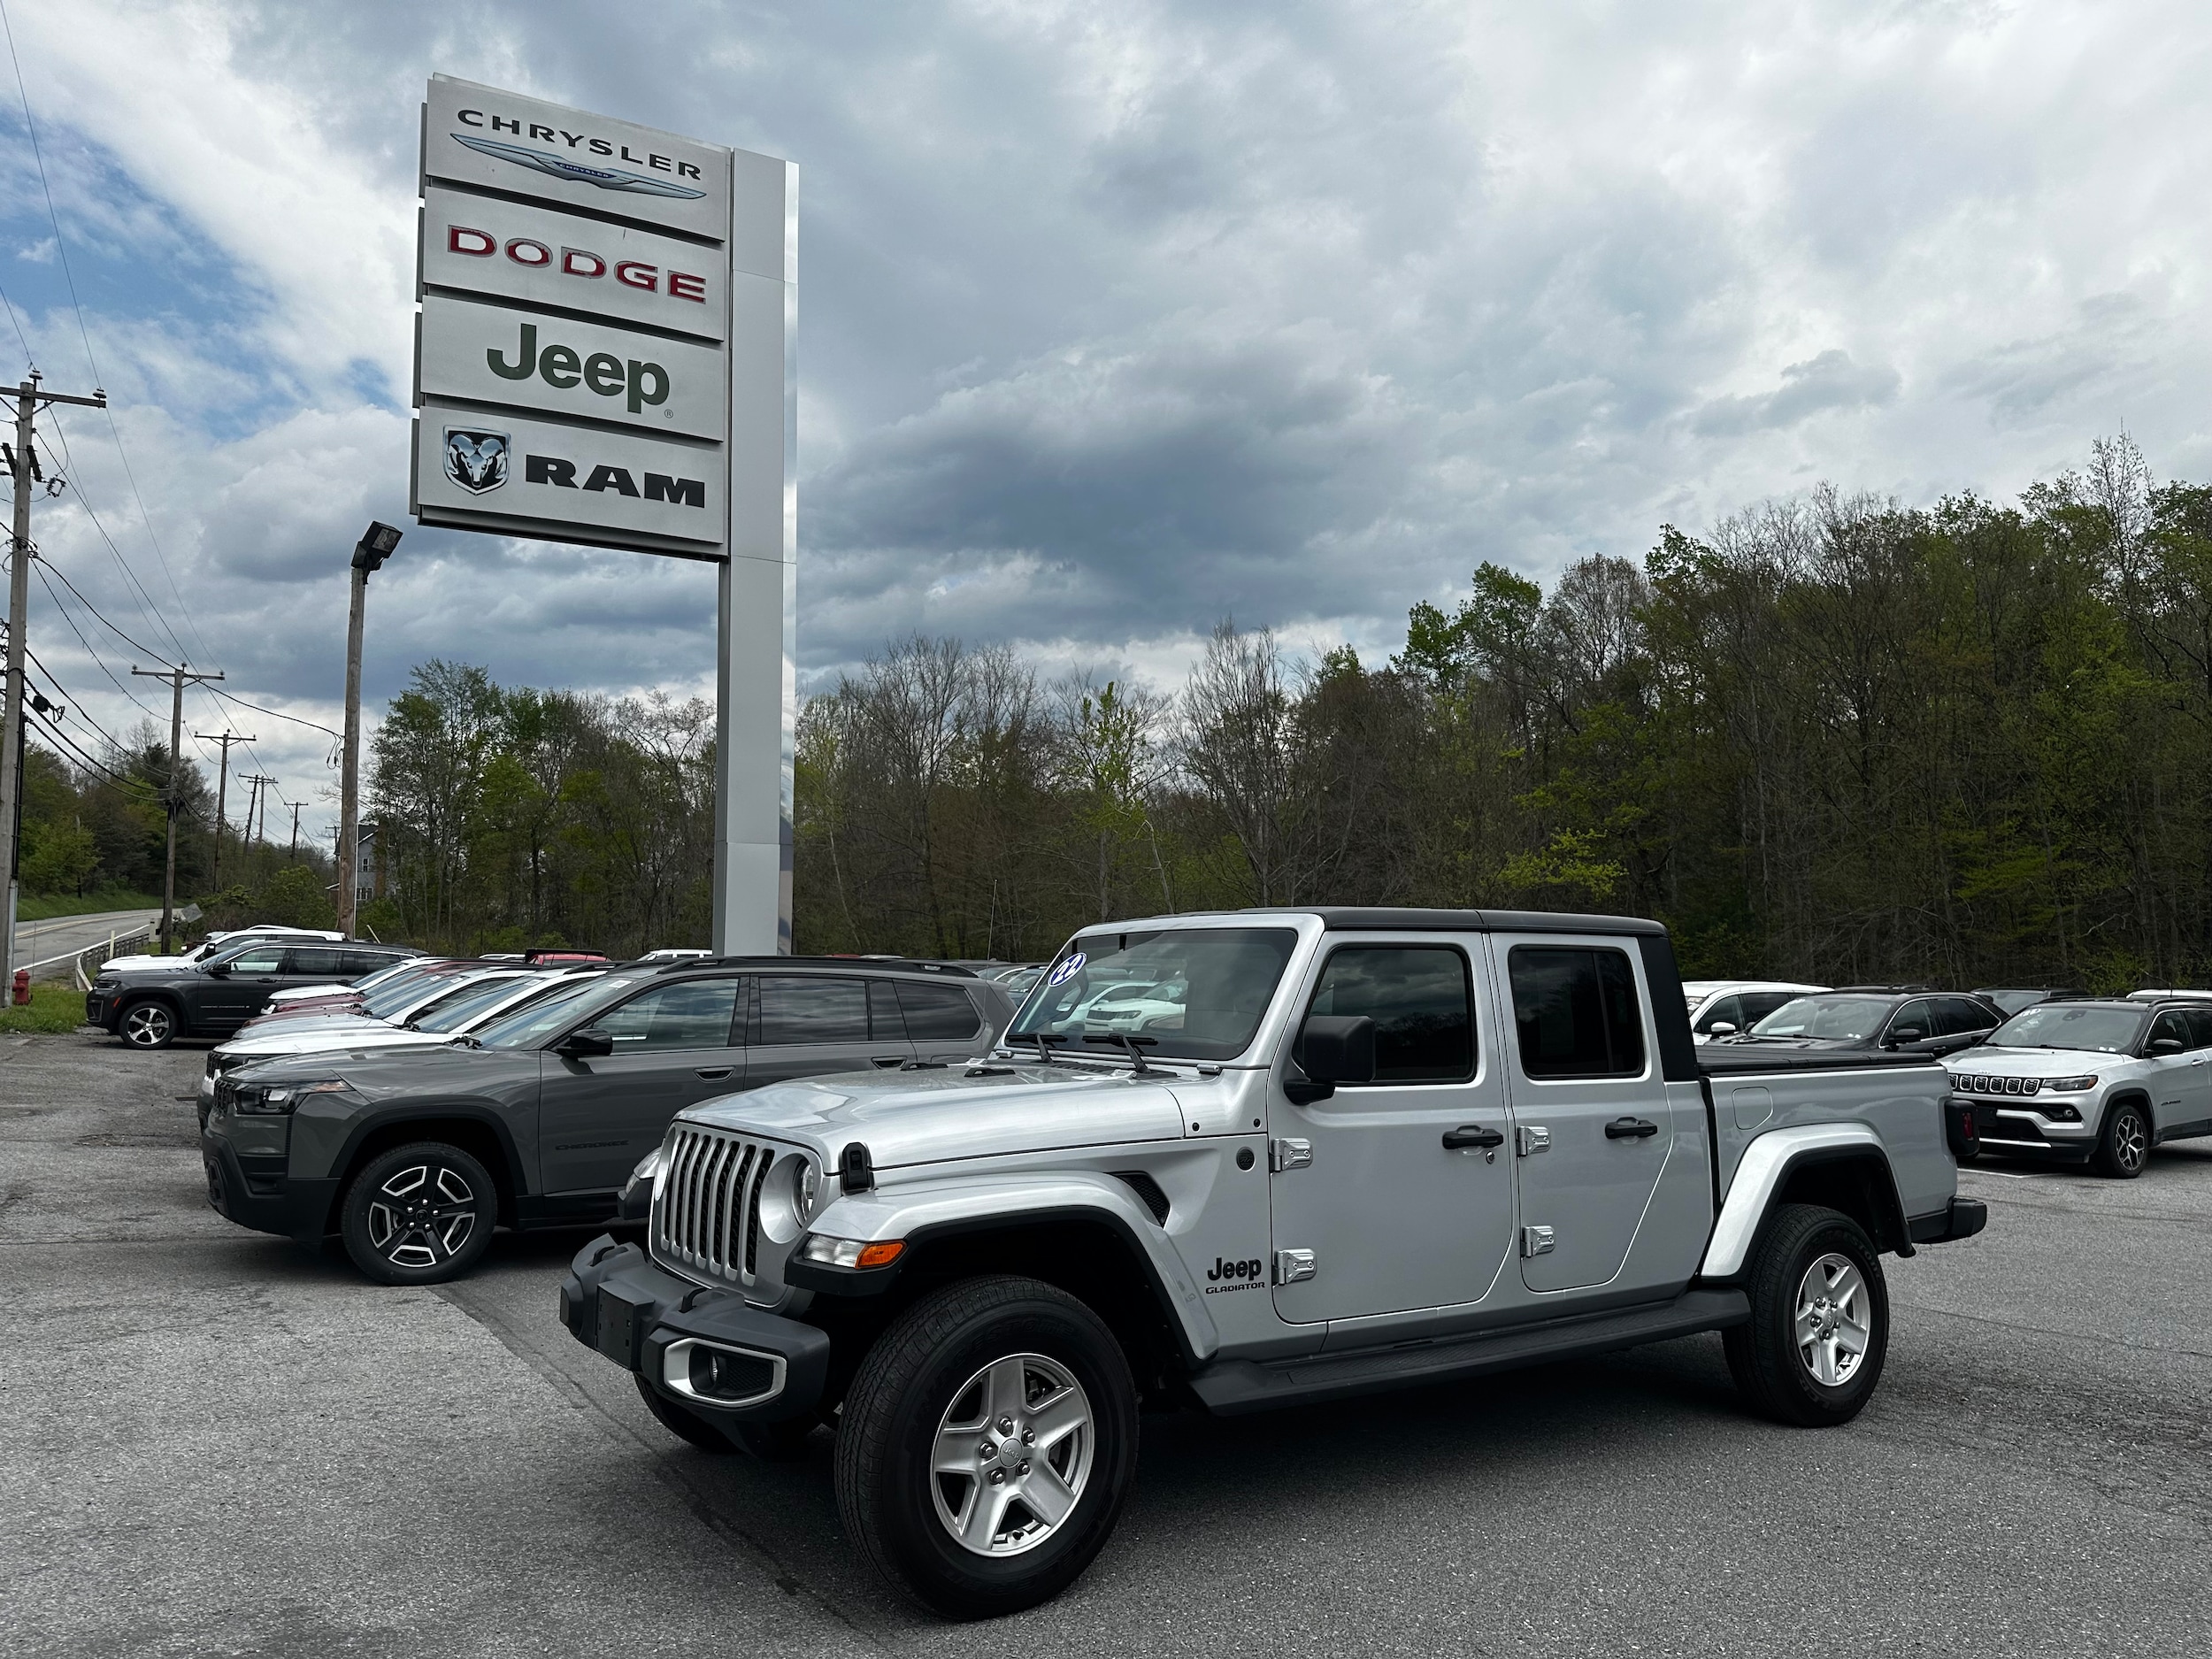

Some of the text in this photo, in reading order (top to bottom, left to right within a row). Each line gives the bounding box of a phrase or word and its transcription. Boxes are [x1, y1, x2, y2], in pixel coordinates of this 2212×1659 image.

[457, 110, 701, 180] CHRYSLER
[559, 163, 609, 178] CHRYSLER
[448, 225, 706, 304] DODGE
[487, 323, 670, 413] Jeep
[526, 454, 705, 509] RAM
[1052, 955, 1082, 985] 22
[555, 1140, 629, 1150] CHEROKEE
[1207, 1257, 1262, 1281] Jeep
[1205, 1282, 1265, 1294] GLADIATOR
